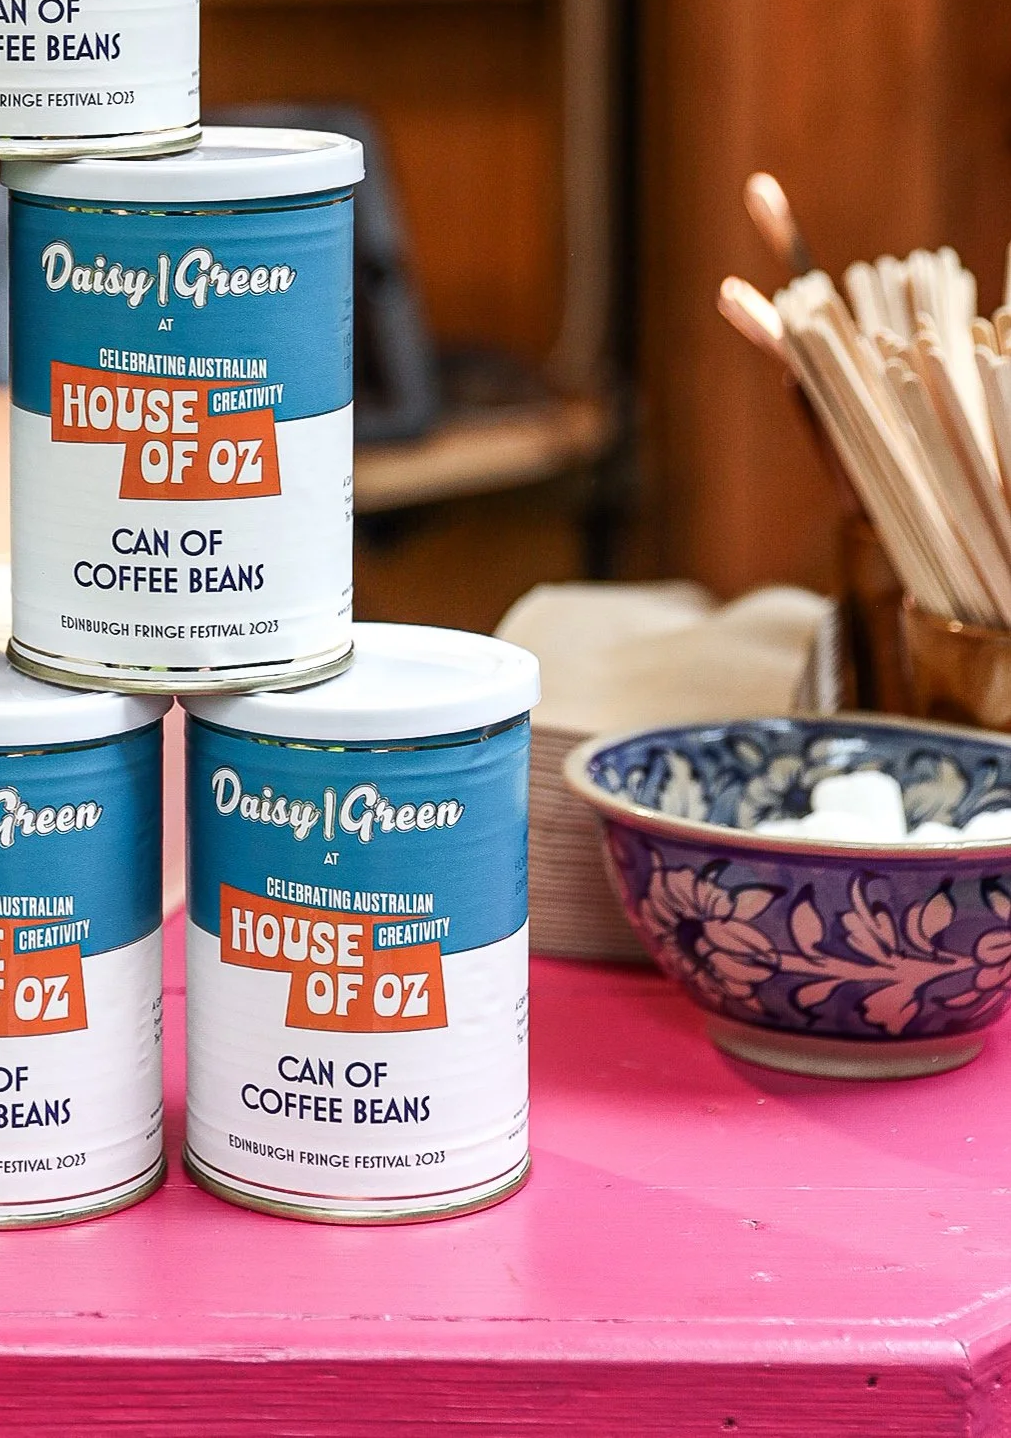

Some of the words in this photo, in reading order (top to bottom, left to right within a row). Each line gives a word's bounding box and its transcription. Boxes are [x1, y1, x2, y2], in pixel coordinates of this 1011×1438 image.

[48, 33, 120, 61] BEANS
[48, 93, 103, 106] FESTIVAL
[107, 91, 134, 105] 2023
[158, 319, 173, 331] AT
[100, 348, 185, 376] CELEBRATING
[188, 357, 266, 378] AUSTRALIAN
[64, 384, 198, 433] HOUSE
[213, 384, 283, 412] CREATIVITY
[141, 441, 198, 483] OF
[209, 440, 262, 484] OZ
[112, 528, 168, 558] CAN
[181, 530, 222, 556] OF
[74, 561, 177, 593] COFFEE
[190, 564, 263, 593] BEANS
[62, 615, 129, 636] EDINBURGH
[135, 625, 184, 638] FRINGE
[191, 624, 245, 638] FESTIVAL
[250, 620, 278, 634] 2023
[324, 853, 339, 865] AT
[267, 877, 350, 909] CELEBRATING
[353, 892, 433, 913] AUSTRALIAN
[19, 919, 90, 950] CREATIVITY
[232, 908, 363, 967] HOUSE
[379, 916, 450, 946] CREATIVITY
[15, 976, 68, 1020] OZ
[307, 972, 363, 1015] OF
[374, 974, 428, 1017] OZ
[278, 1056, 333, 1088] CAN
[345, 1062, 387, 1087] OF
[242, 1084, 342, 1123] COFFEE
[354, 1096, 429, 1123] BEANS
[57, 1153, 85, 1169] 2023
[229, 1134, 294, 1162] EDINBURGH
[300, 1152, 349, 1168] FRINGE
[355, 1155, 411, 1168] FESTIVAL
[416, 1151, 445, 1165] 2023
